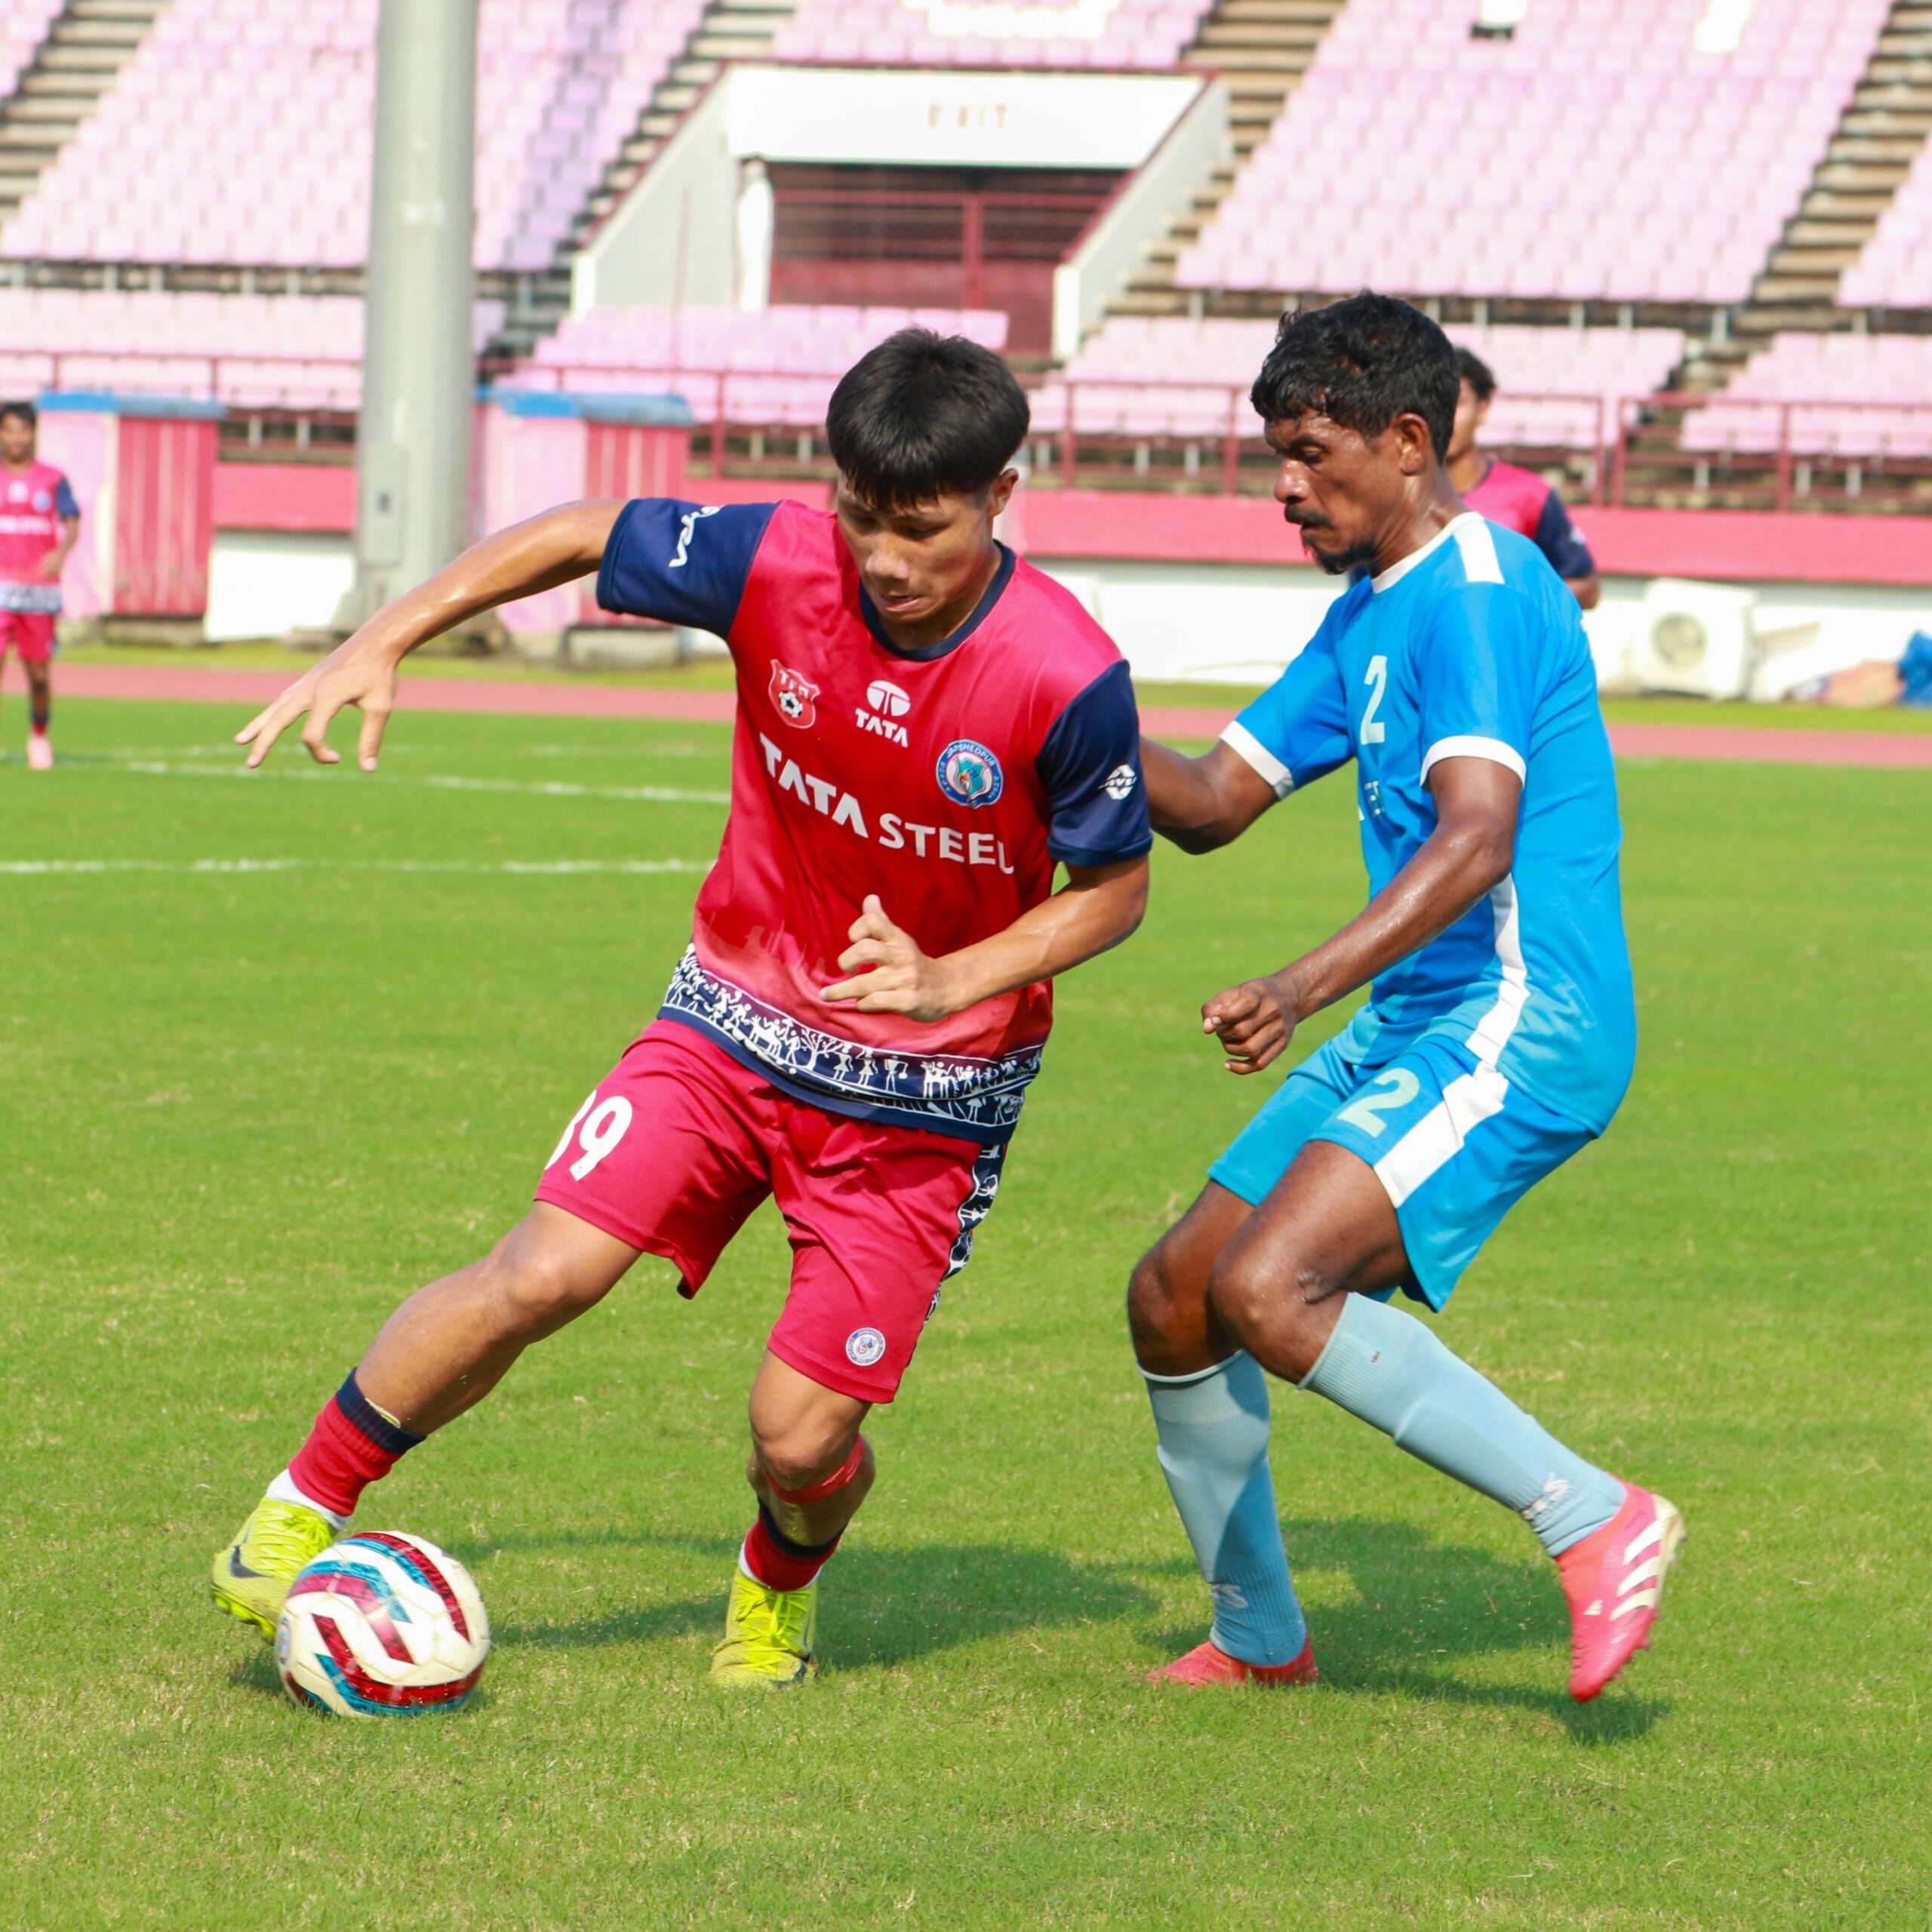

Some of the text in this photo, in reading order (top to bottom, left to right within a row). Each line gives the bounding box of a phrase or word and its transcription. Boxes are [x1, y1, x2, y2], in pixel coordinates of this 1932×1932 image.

[854, 708, 908, 748] TATA
[1361, 655, 1387, 746] 2
[759, 732, 1014, 874] TATA STEEL
[1337, 1068, 1420, 1138] 2
